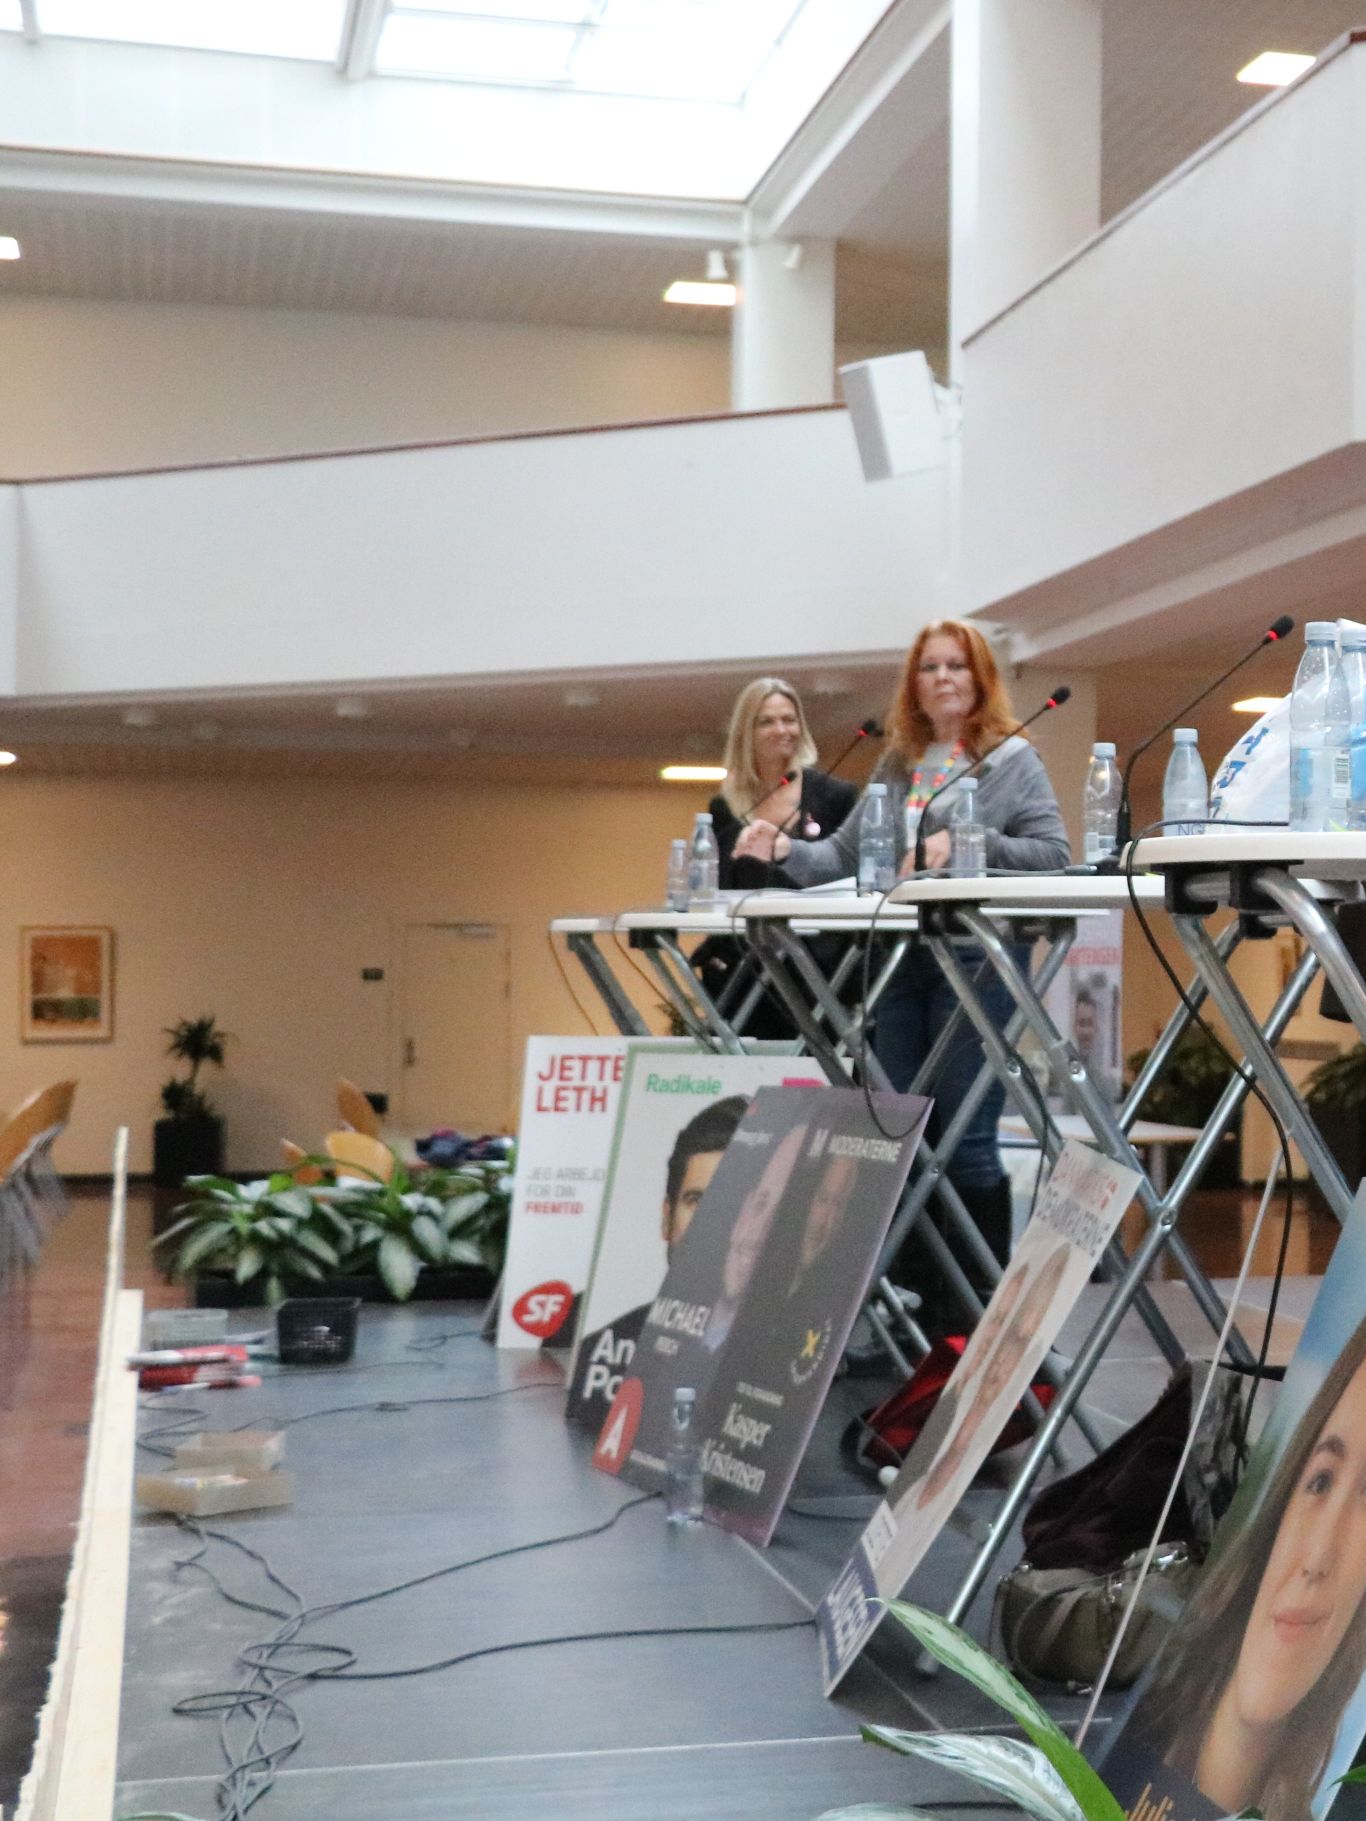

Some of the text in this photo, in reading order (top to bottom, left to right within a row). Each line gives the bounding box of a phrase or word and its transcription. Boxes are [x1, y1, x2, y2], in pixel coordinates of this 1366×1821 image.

[538, 1054, 626, 1082] JETTE
[645, 1073, 722, 1095] Radikale
[535, 1086, 608, 1113] LETH
[525, 1201, 584, 1216] FREMTID
[521, 1294, 566, 1323] SF
[647, 1300, 711, 1337] MICHAEL
[599, 1406, 629, 1459] A
[722, 1402, 771, 1448] Kasper
[702, 1438, 766, 1494] Kristensen
